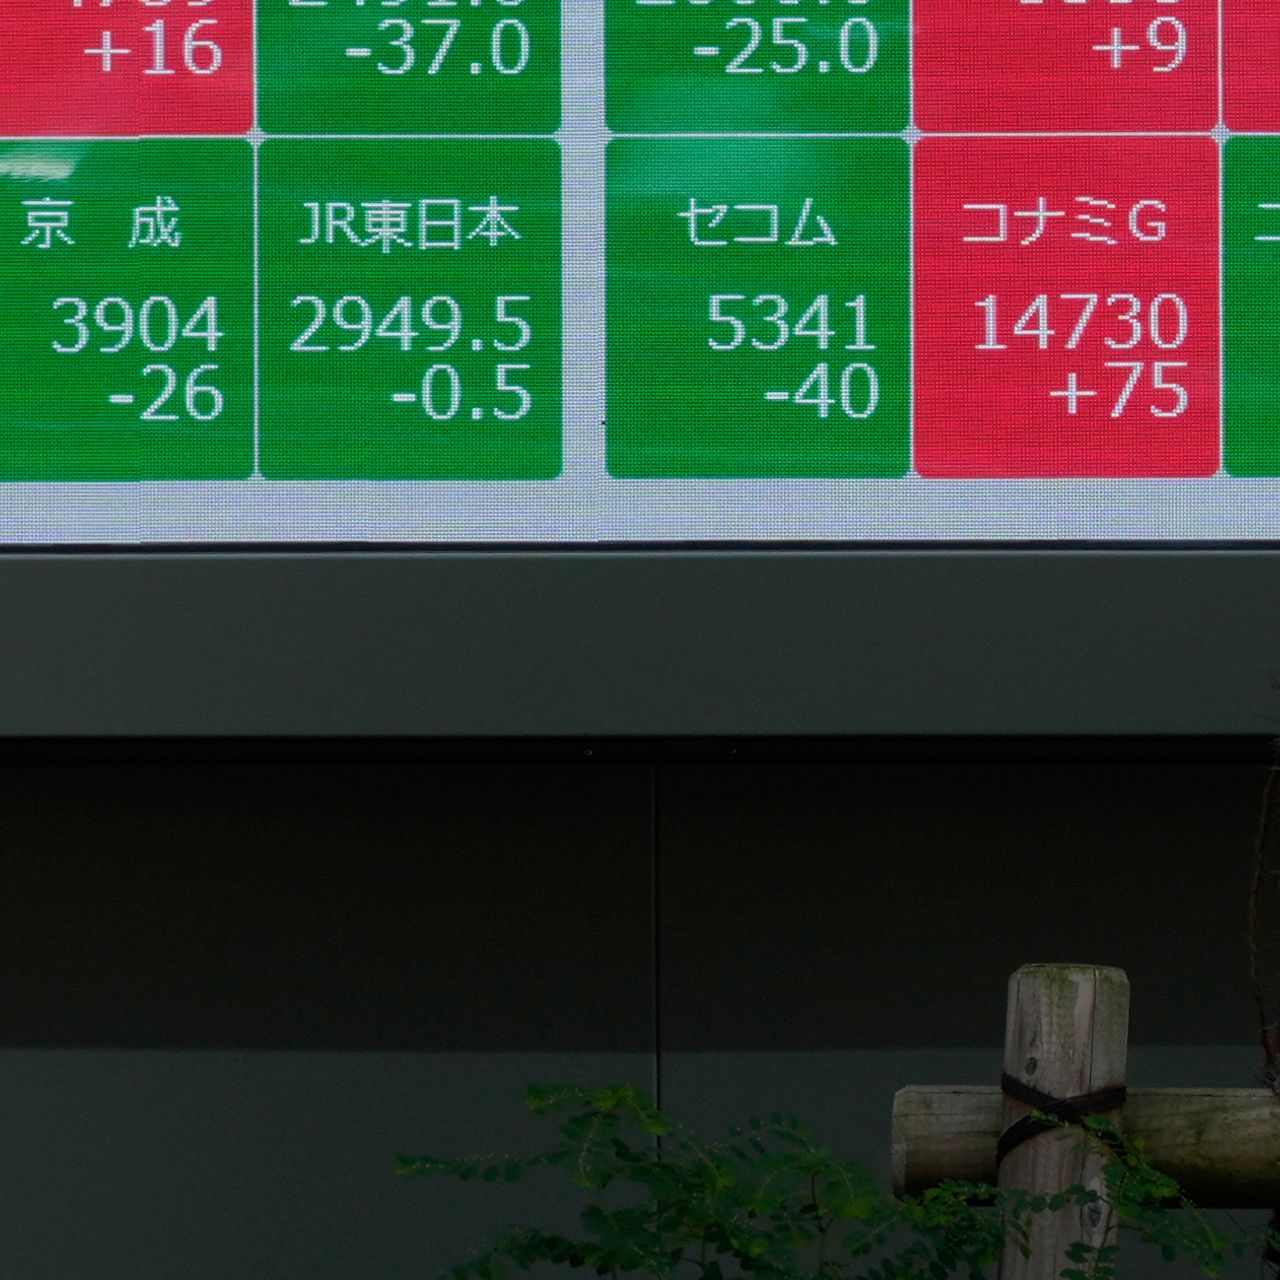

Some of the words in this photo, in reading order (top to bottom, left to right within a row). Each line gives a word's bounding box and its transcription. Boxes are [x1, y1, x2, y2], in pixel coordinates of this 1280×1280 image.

[84, 18, 223, 75] +16
[346, 18, 530, 75] -37.0
[694, 17, 879, 74] -25.0
[1093, 15, 1188, 73] +9
[301, 197, 519, 252] JR東日本
[679, 198, 837, 247] セコム
[53, 295, 222, 353] 3904
[291, 295, 531, 352] 2949.5
[709, 294, 874, 351] 5341
[976, 293, 1188, 350] 14730
[110, 363, 224, 421] -26
[392, 363, 532, 421] -0.5
[765, 362, 879, 419] -40
[1050, 361, 1189, 418] +75
